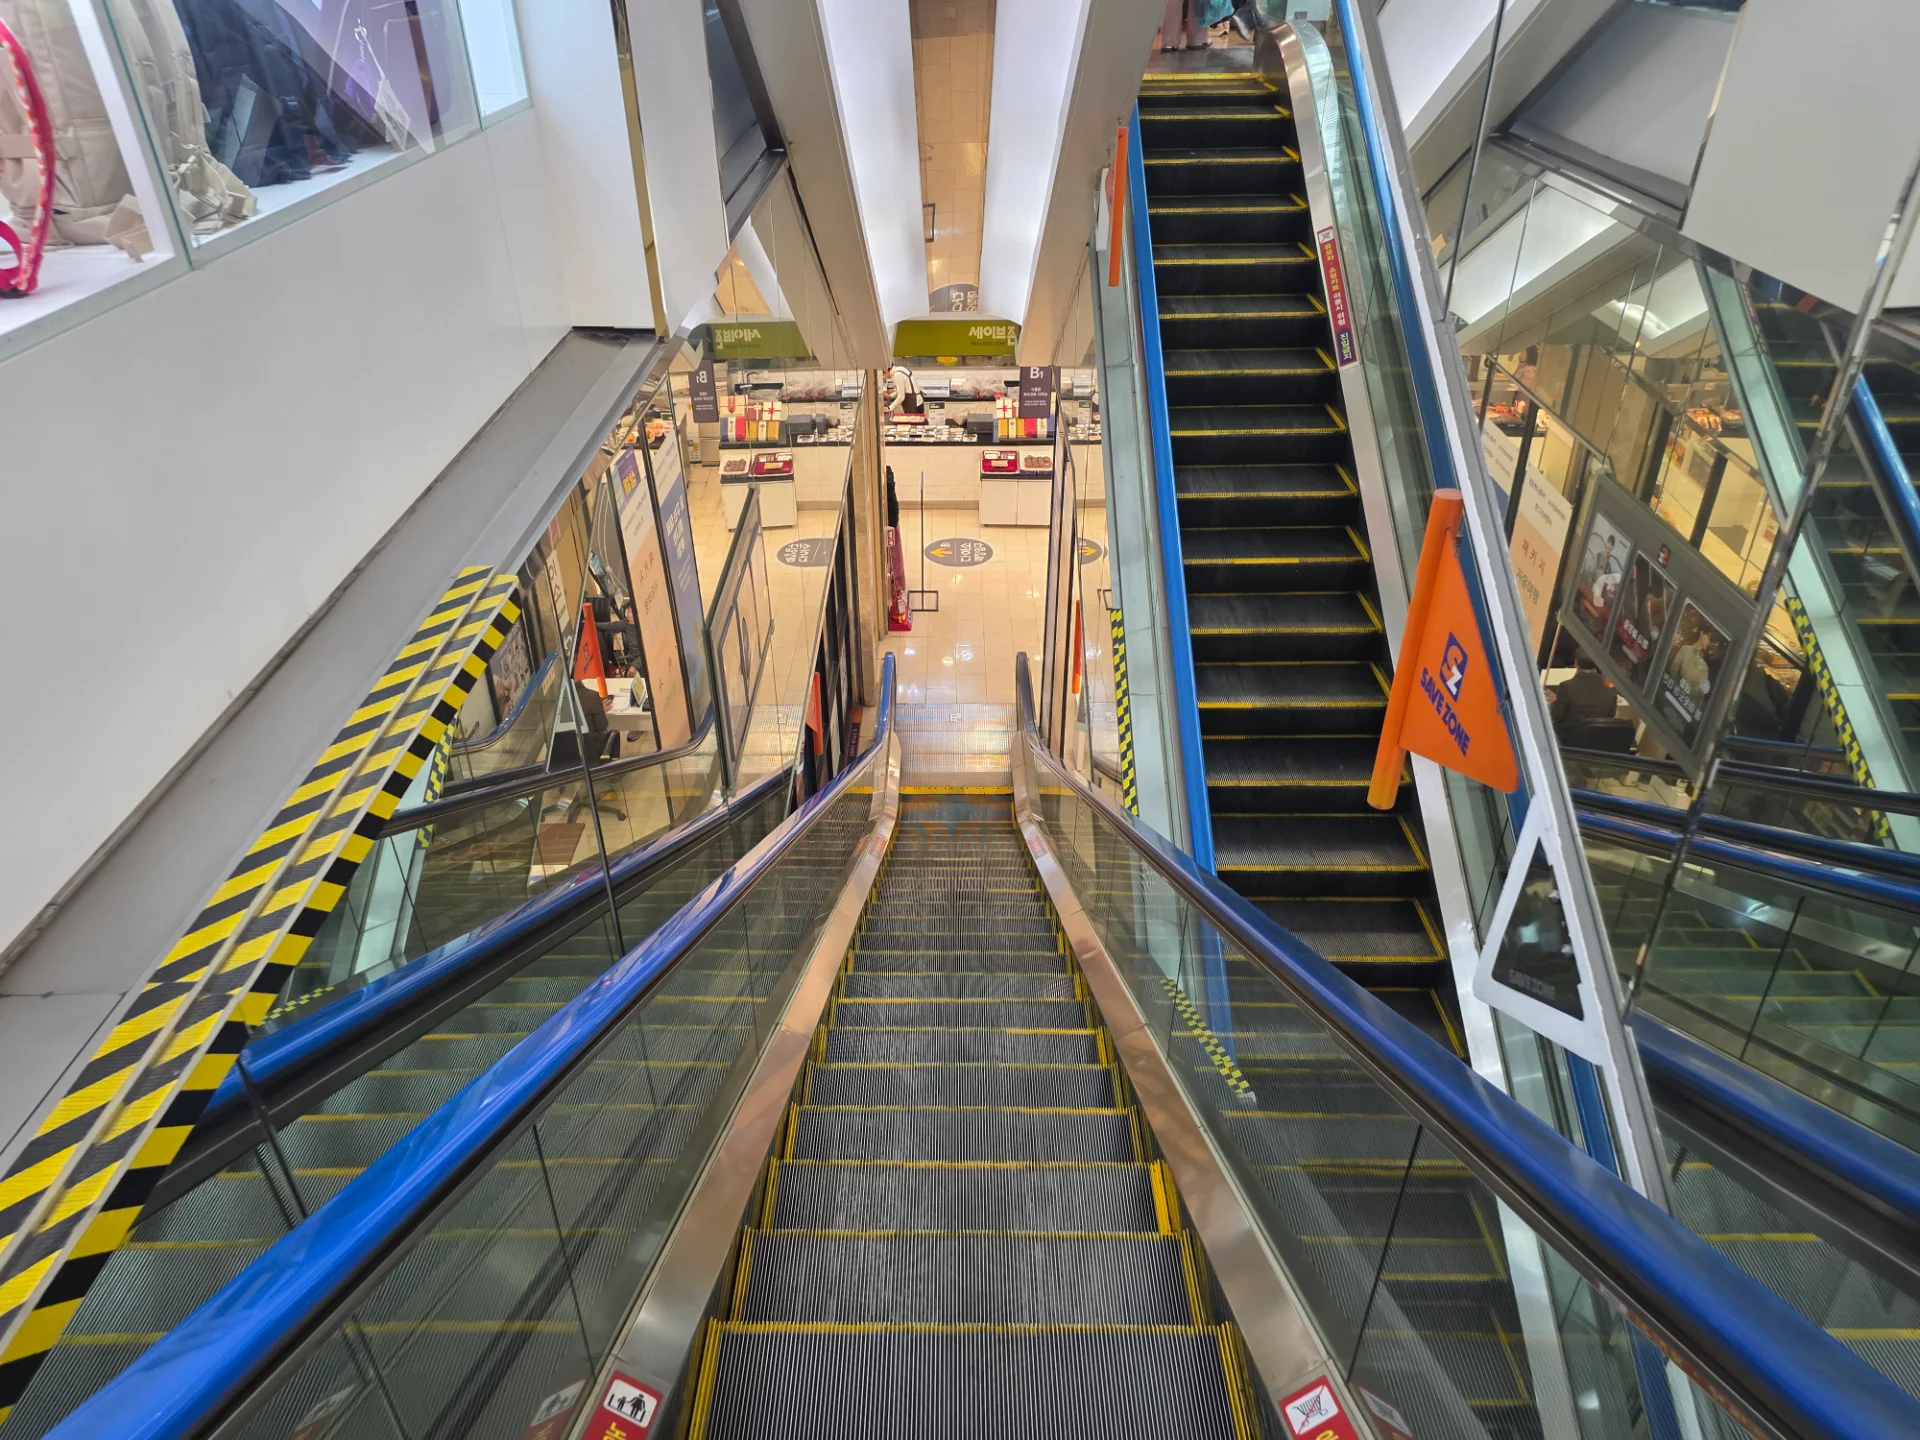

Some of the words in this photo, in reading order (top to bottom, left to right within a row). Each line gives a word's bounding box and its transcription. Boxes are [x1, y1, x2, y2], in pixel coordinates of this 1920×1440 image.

[968, 326, 1016, 346] 세이브존
[1029, 366, 1044, 379] B1
[960, 542, 972, 563] 다이소
[1419, 667, 1444, 716] SAVE
[1440, 706, 1470, 757] ZONE
